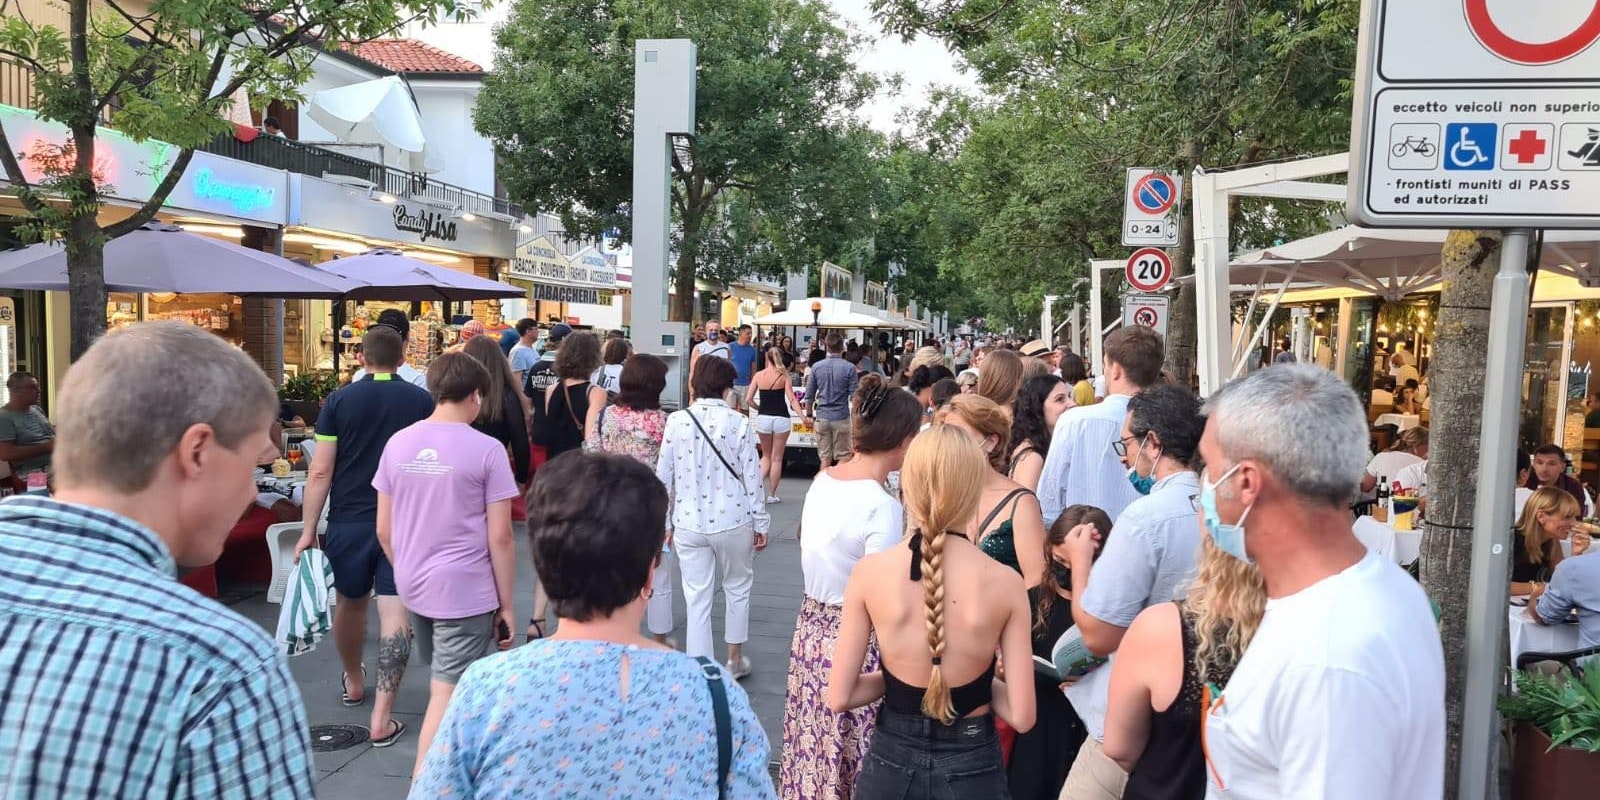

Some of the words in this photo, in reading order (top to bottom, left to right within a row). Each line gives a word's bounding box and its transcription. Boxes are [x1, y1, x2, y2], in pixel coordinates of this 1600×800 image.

[1393, 101, 1448, 113] eccetto
[1455, 101, 1502, 113] veicoli
[1510, 103, 1537, 113] non
[1395, 179, 1452, 190] frontisti
[1458, 179, 1502, 190] muniti
[1508, 179, 1522, 190] di
[1529, 179, 1570, 190] PASS
[1394, 193, 1410, 204] ed
[1416, 193, 1488, 205] autorizzati
[512, 257, 537, 275] TABACCHI
[1138, 260, 1163, 279] 20
[533, 283, 598, 304] TABACCHERIA
